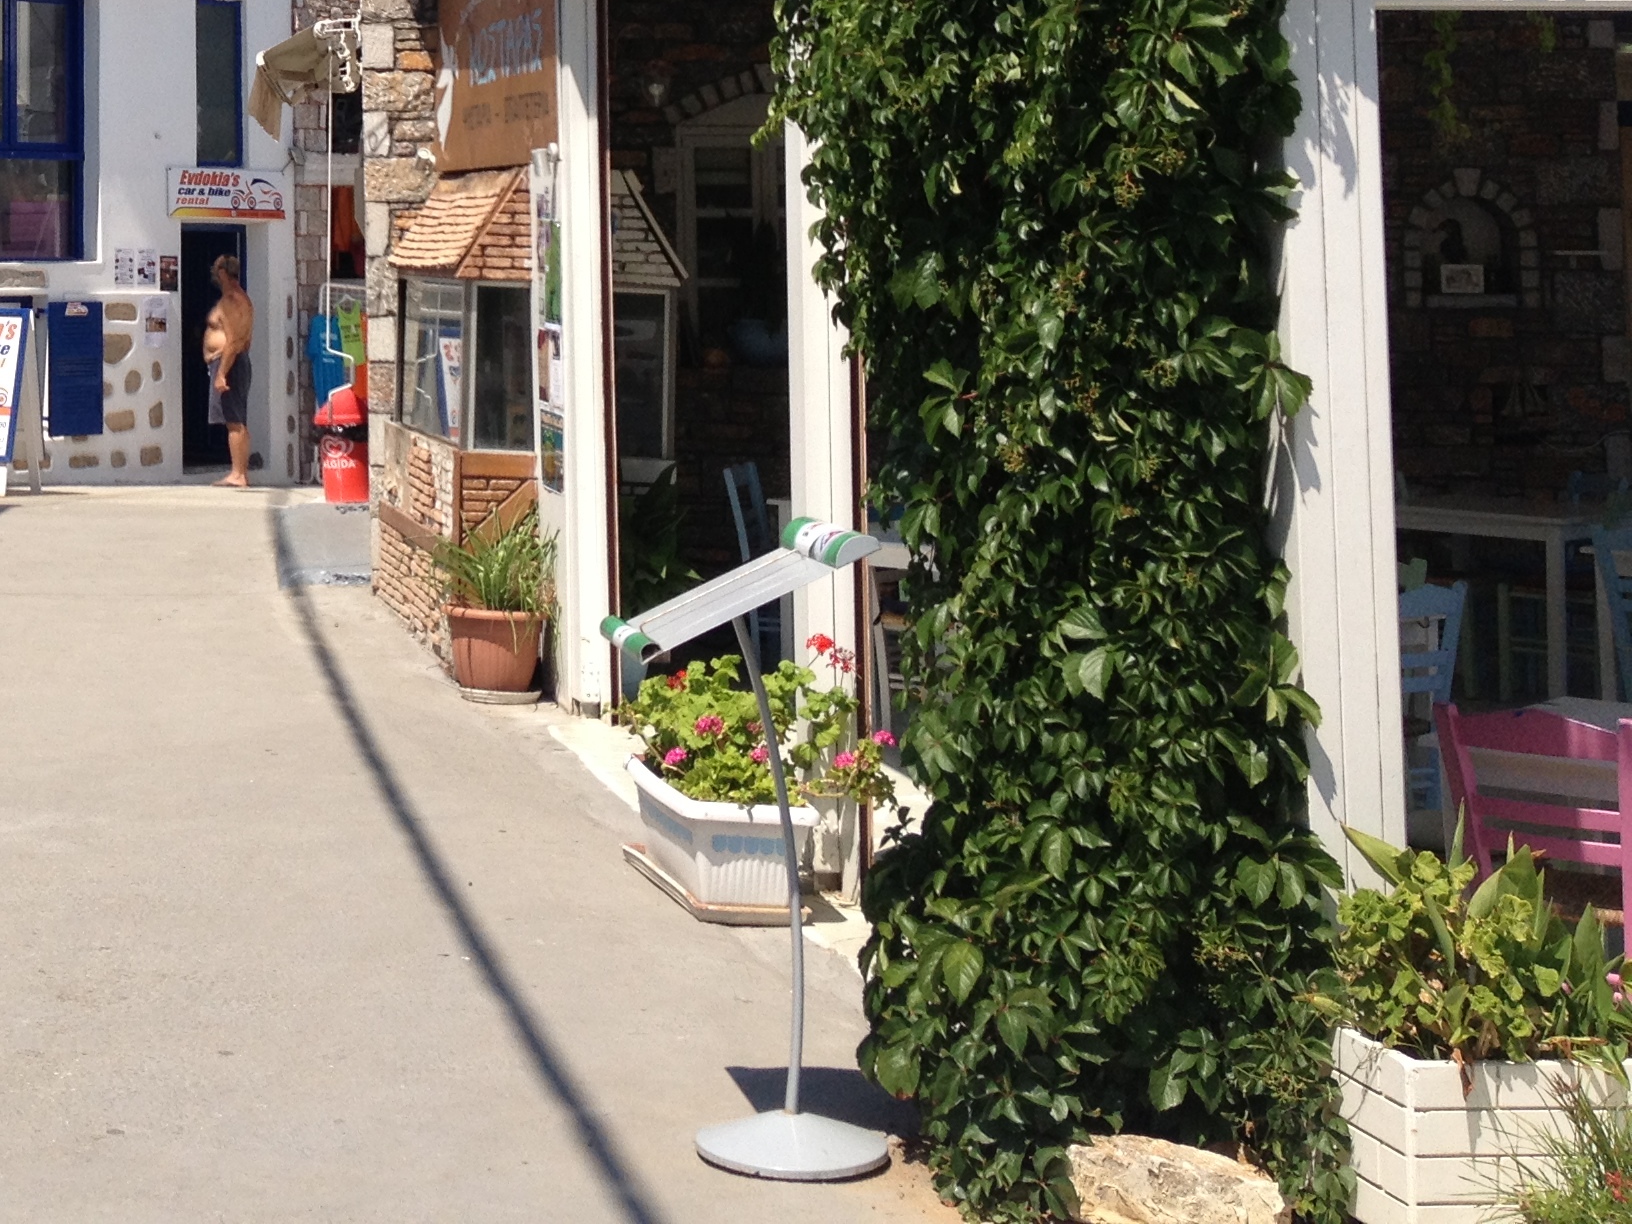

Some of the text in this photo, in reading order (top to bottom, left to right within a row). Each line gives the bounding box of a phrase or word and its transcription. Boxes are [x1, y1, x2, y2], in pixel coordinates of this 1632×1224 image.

[179, 169, 241, 187] Evdokia's
[178, 187, 231, 197] car & bike
[176, 197, 210, 205] rental
